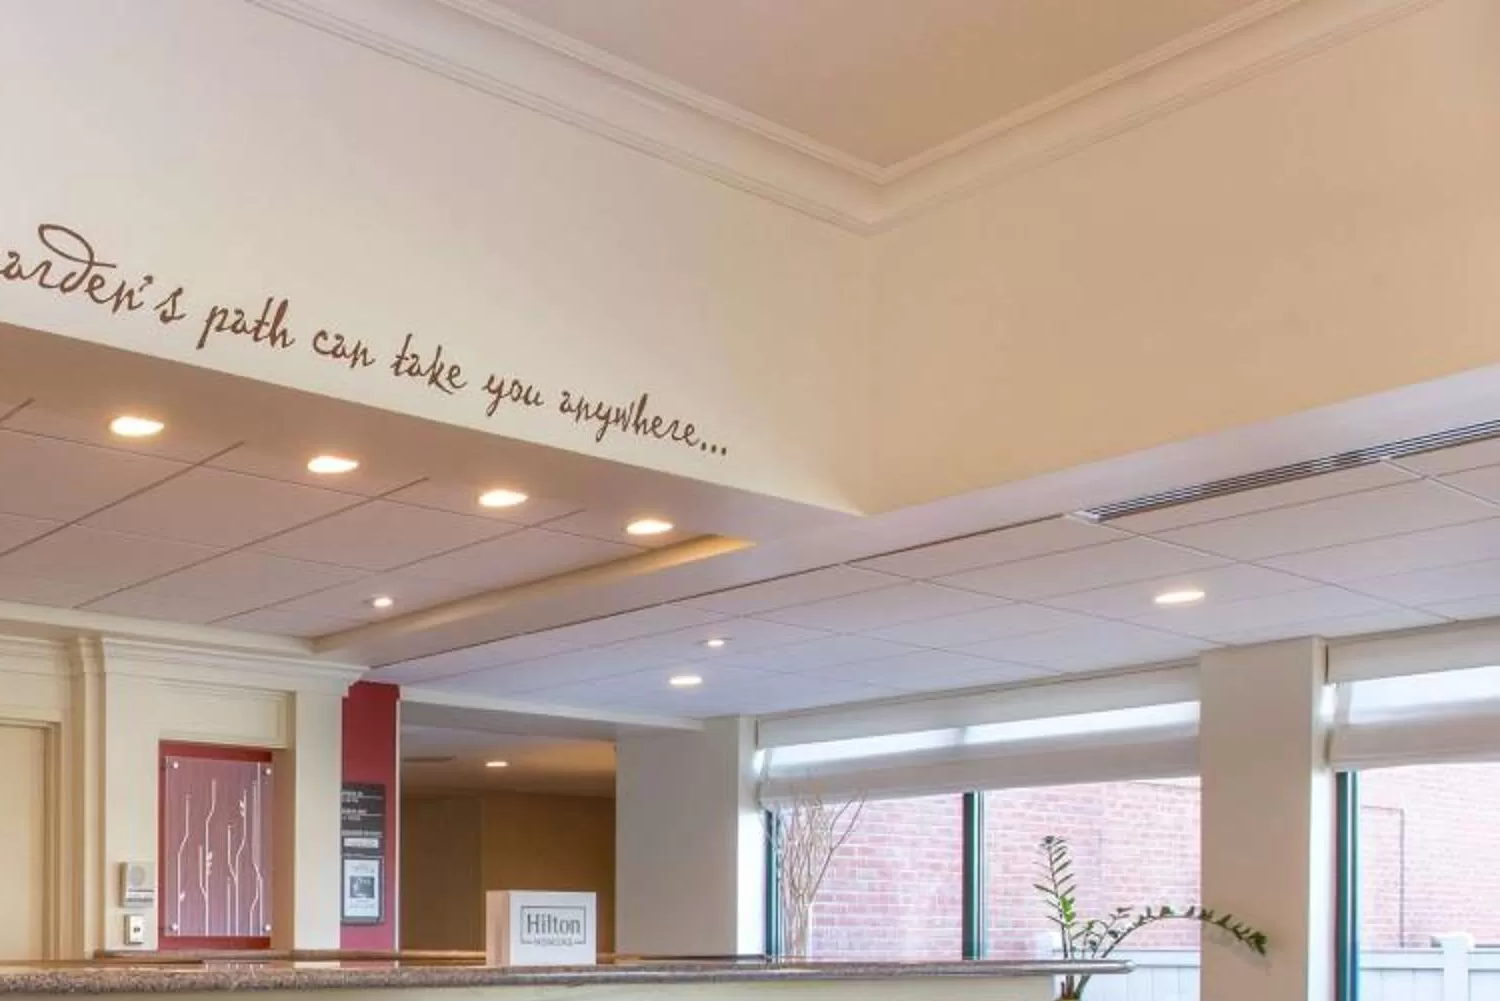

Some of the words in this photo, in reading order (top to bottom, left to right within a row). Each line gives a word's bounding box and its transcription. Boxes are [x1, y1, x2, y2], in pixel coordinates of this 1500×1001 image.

[196, 297, 295, 349] path
[312, 328, 376, 369] can
[389, 333, 467, 395] take
[482, 369, 544, 416] you
[559, 393, 727, 456] anywhere...
[527, 912, 581, 934] Hilton
